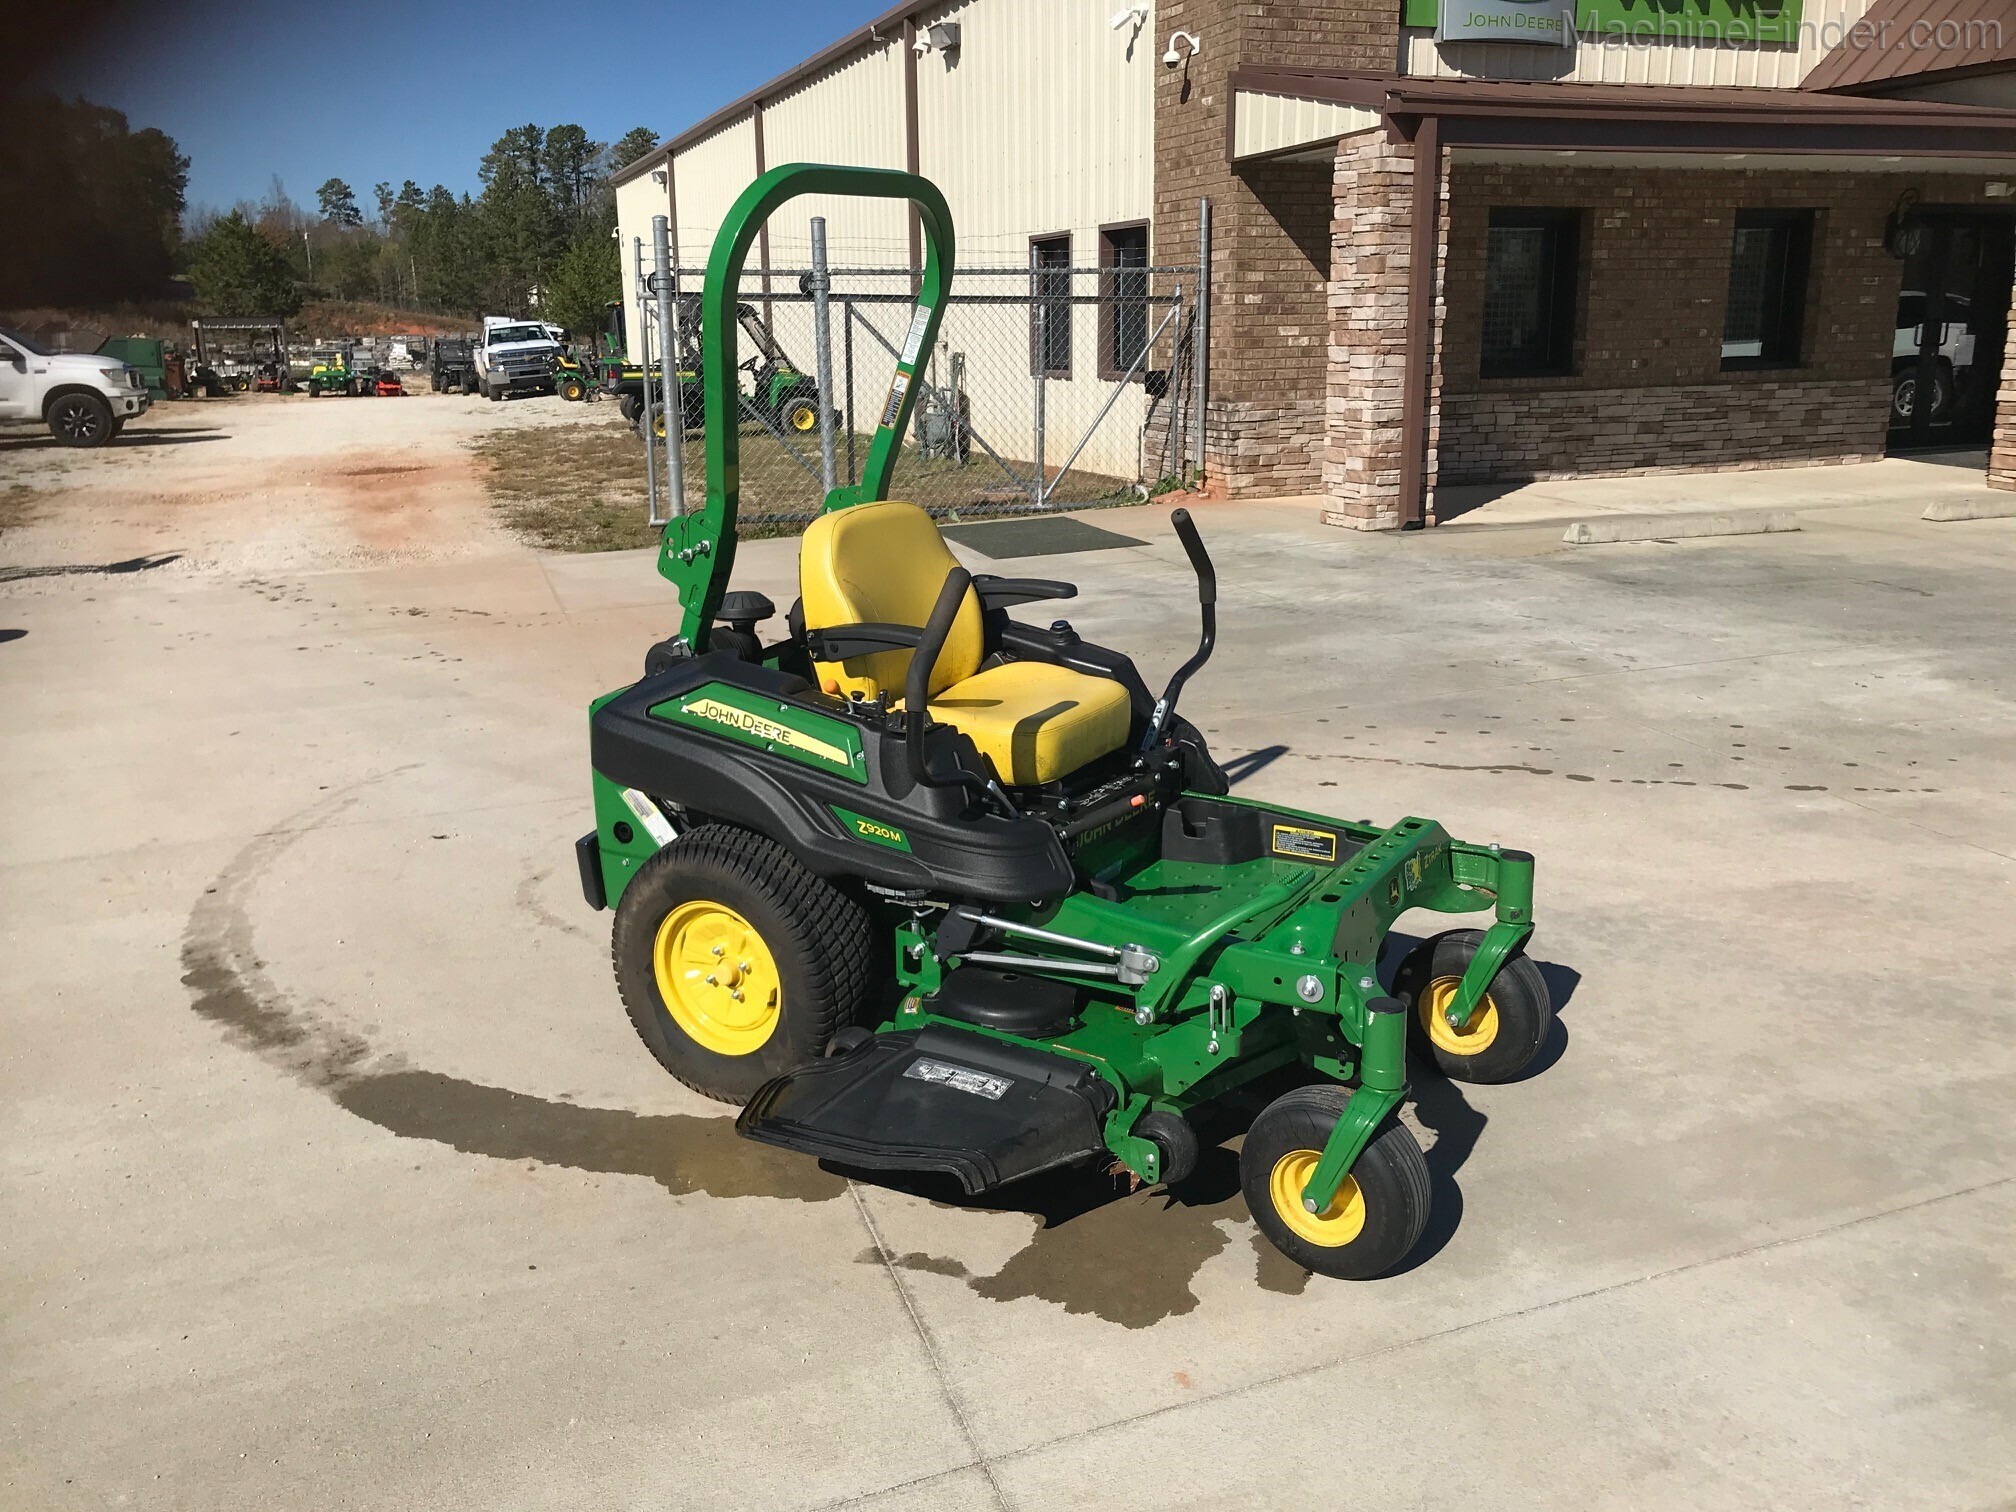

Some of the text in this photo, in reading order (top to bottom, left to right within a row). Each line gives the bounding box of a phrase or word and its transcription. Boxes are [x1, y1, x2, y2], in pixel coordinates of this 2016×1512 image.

[1463, 12, 1563, 31] JOHN DEERE
[700, 702, 791, 743] JOHN DEERE
[856, 820, 902, 843] Z920M
